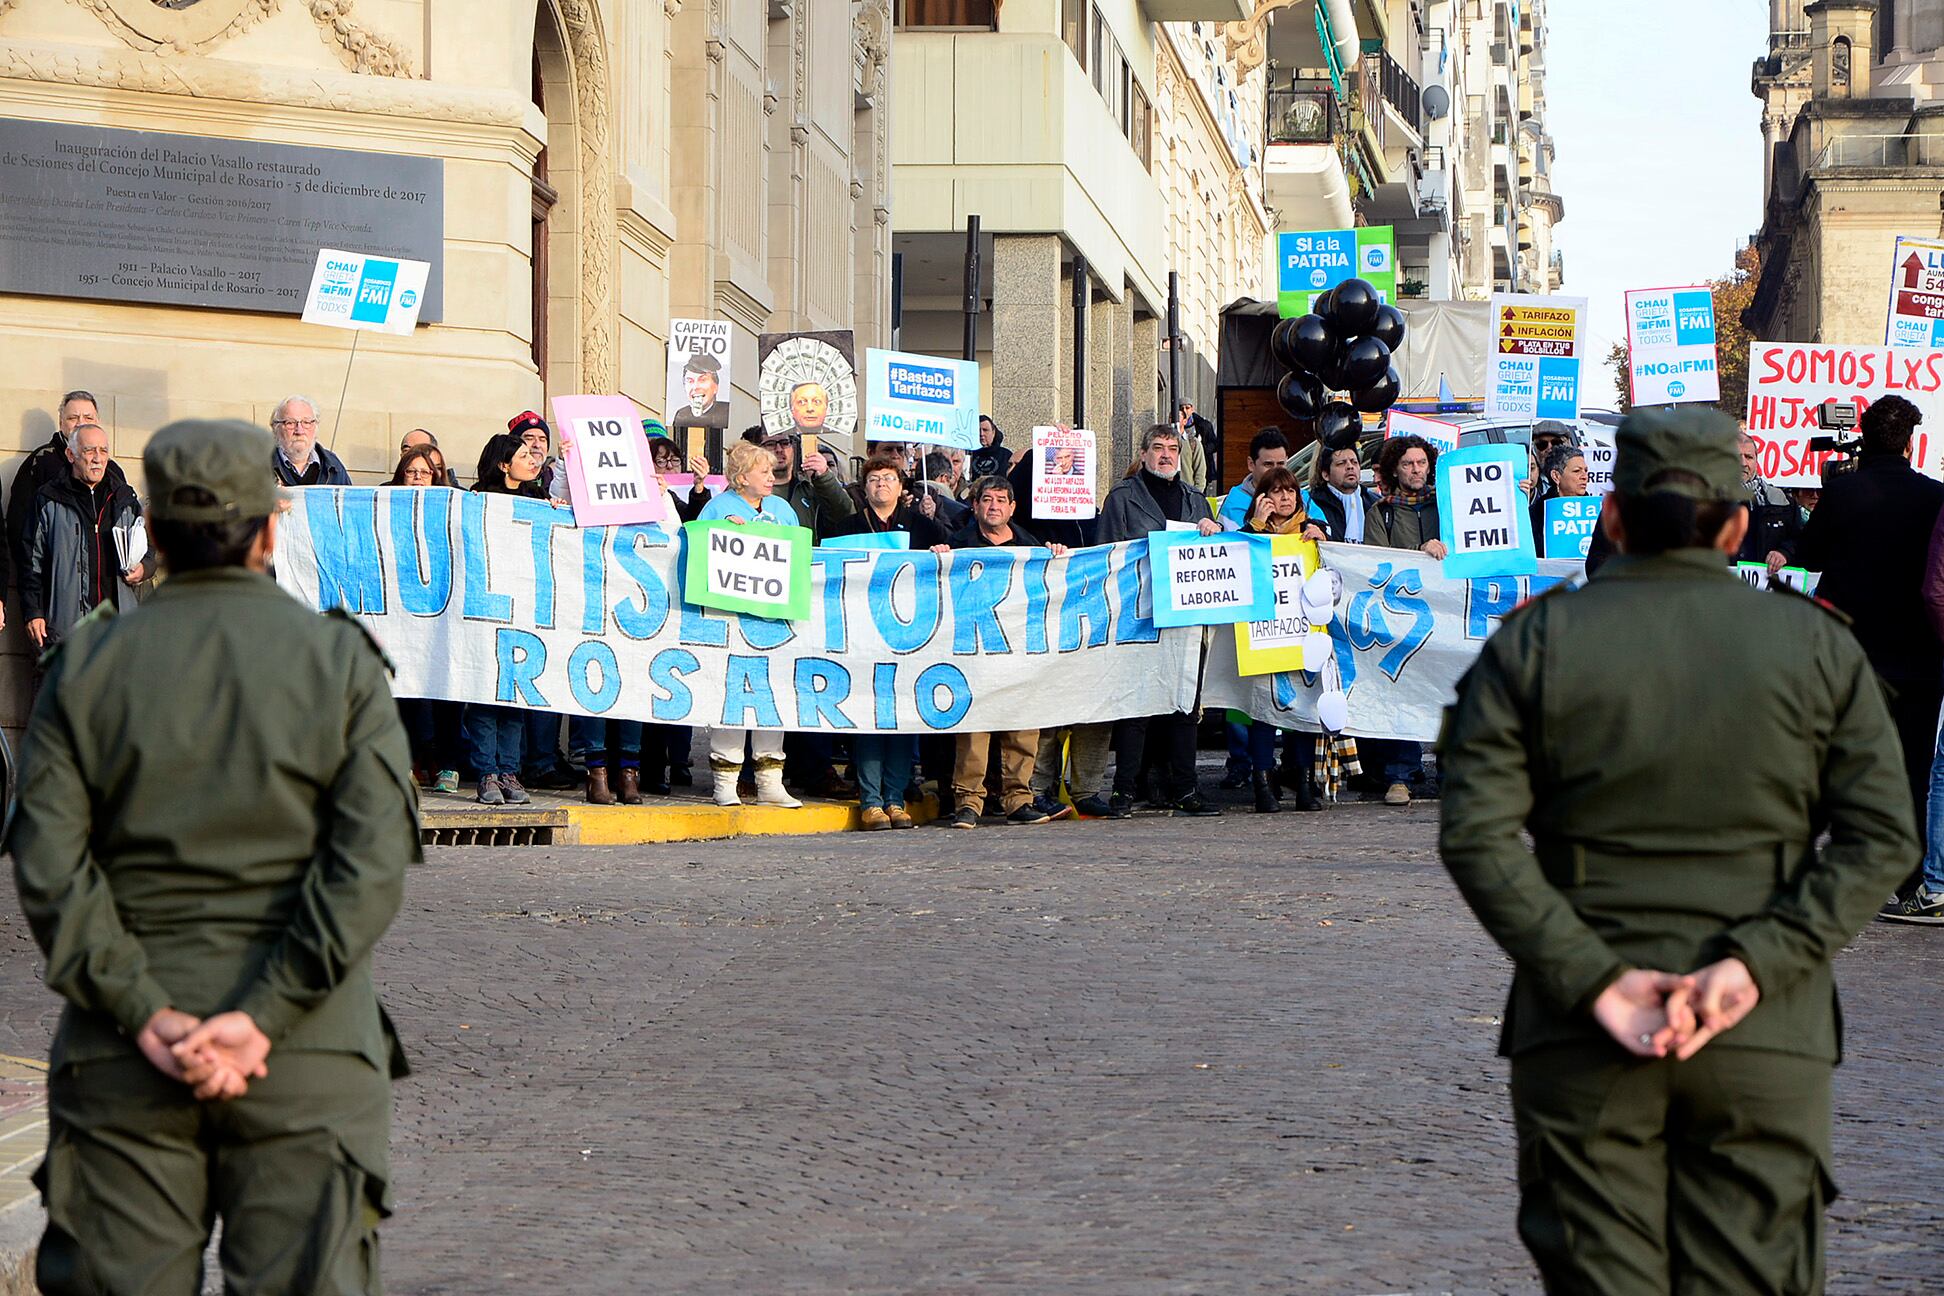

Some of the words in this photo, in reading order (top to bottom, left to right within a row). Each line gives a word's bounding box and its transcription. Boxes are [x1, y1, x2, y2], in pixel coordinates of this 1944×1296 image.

[55, 140, 137, 159] Inauguración
[140, 148, 158, 161] del
[163, 150, 207, 166] Palacio
[211, 154, 253, 170] Vasallo
[257, 161, 321, 177] restaurado
[2, 152, 17, 165] de
[21, 154, 73, 171] Sesiones
[77, 159, 95, 172] del
[100, 160, 150, 179] Concejo
[153, 165, 216, 185] Municipal
[219, 172, 234, 185] de
[238, 172, 284, 190] Rosario
[294, 181, 301, 194] 5
[305, 179, 319, 192] de
[322, 181, 380, 198] diciembre
[383, 186, 398, 199] de
[400, 191, 426, 204] 2017
[106, 186, 136, 198] Puesta
[138, 190, 150, 200] en
[152, 190, 177, 202] Valor
[188, 193, 223, 206] Gestión
[1295, 237, 1312, 252] SI
[1316, 240, 1326, 251] a
[1327, 236, 1340, 251] la
[326, 261, 358, 273] CHAU
[1287, 252, 1349, 269] PATRIA
[119, 262, 138, 273] 1911
[151, 263, 187, 277] Palacio
[190, 265, 226, 279] Vasallo
[238, 271, 262, 282] 2017
[79, 274, 99, 285] 1951
[112, 274, 154, 290] Concejo
[156, 277, 209, 294] Municipal
[212, 282, 223, 293] de
[226, 282, 265, 295] Rosario
[277, 287, 299, 299] 2017
[331, 285, 352, 297] FMI
[358, 287, 390, 306] FMI
[1635, 299, 1668, 309] CHAU
[316, 301, 348, 314] TODXS
[1521, 310, 1571, 321] TARIFAZO
[1635, 307, 1669, 317] GRIETA
[675, 321, 727, 335] CAPITÁN
[1648, 319, 1671, 329] FMI
[1680, 316, 1711, 330] FMI
[1896, 320, 1928, 332] CHAU
[1518, 326, 1572, 338] INFLACIÓN
[1638, 334, 1672, 345] TODXS
[1895, 329, 1926, 340] GRIETA
[675, 335, 727, 355] VETO
[1519, 340, 1541, 348] PLATA
[1543, 341, 1553, 349] EN
[1555, 342, 1571, 350] TUS
[1523, 346, 1565, 355] BOLSILLOS
[1499, 361, 1533, 371] CHAU
[1634, 358, 1714, 377] #NOalFMI
[1759, 349, 1876, 389] SOMOS
[890, 367, 953, 387] #BastaDe
[1497, 370, 1532, 380] GRIETA
[891, 380, 951, 399] Tarifazos
[1509, 385, 1532, 395] FMI
[1541, 386, 1574, 402] FMI
[1497, 402, 1531, 413] TODXS
[588, 420, 622, 437] NO
[598, 451, 627, 468] AL
[1593, 450, 1612, 461] NO
[1465, 465, 1502, 484] NO
[596, 482, 638, 500] FMI
[1469, 497, 1502, 515] AL
[1562, 501, 1581, 517] SI
[1585, 504, 1597, 516] a
[1464, 528, 1508, 548] FMI
[712, 533, 745, 557] NO
[753, 542, 787, 563] AL
[1178, 547, 1195, 561] NO
[1199, 547, 1206, 559] A
[1210, 545, 1228, 558] LA
[717, 569, 783, 597] VETO
[1176, 567, 1236, 583] REFORMA
[1181, 590, 1239, 606] LABORAL
[1250, 616, 1309, 638] TARIFAZOS
[495, 627, 973, 730] ROSARIO
